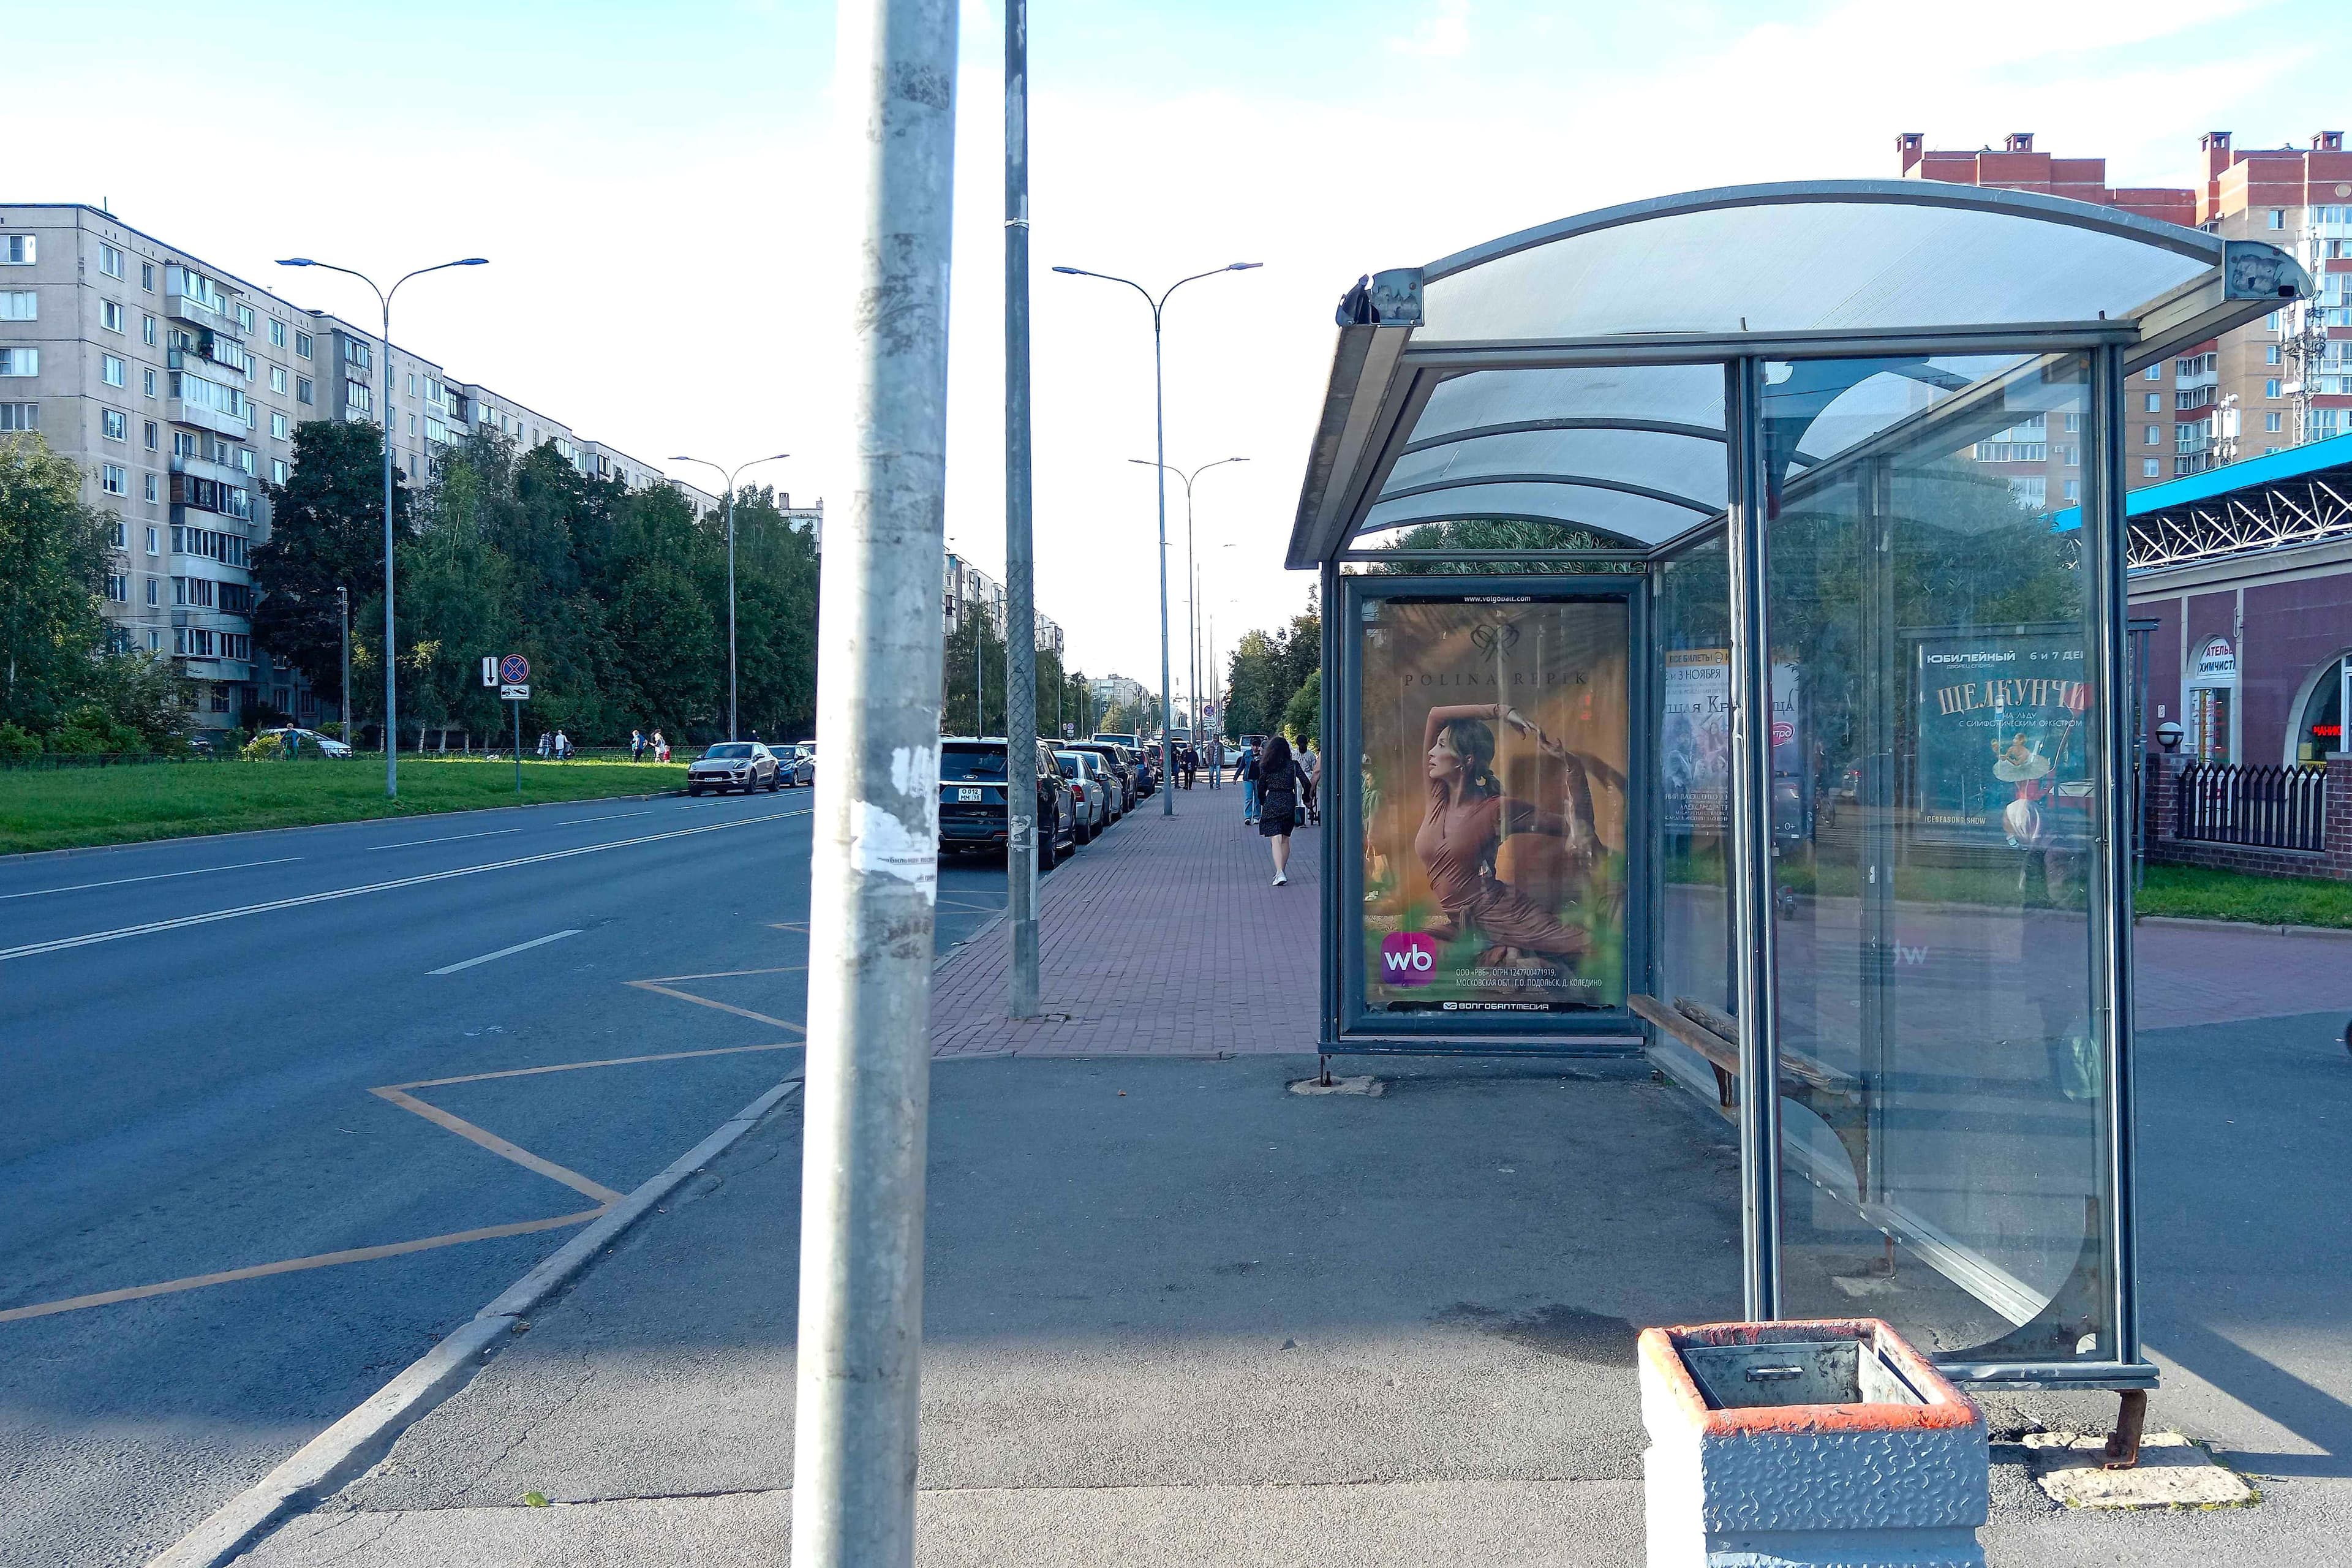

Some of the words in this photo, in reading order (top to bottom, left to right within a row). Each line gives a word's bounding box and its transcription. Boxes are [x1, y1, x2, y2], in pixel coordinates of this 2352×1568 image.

[1683, 654, 1713, 662] БИЛЕТЫ
[1927, 650, 2016, 663] ЮБИЛЕЙНЫЙ
[2030, 652, 2037, 660] 6
[1686, 668, 1721, 679] НОЯБРЯ
[1404, 673, 1497, 687] POLINA
[1513, 673, 1586, 685] REPIK
[1966, 816, 1986, 825] SHOW
[1384, 943, 1433, 971] wb
[1493, 968, 1509, 976] ОГРН
